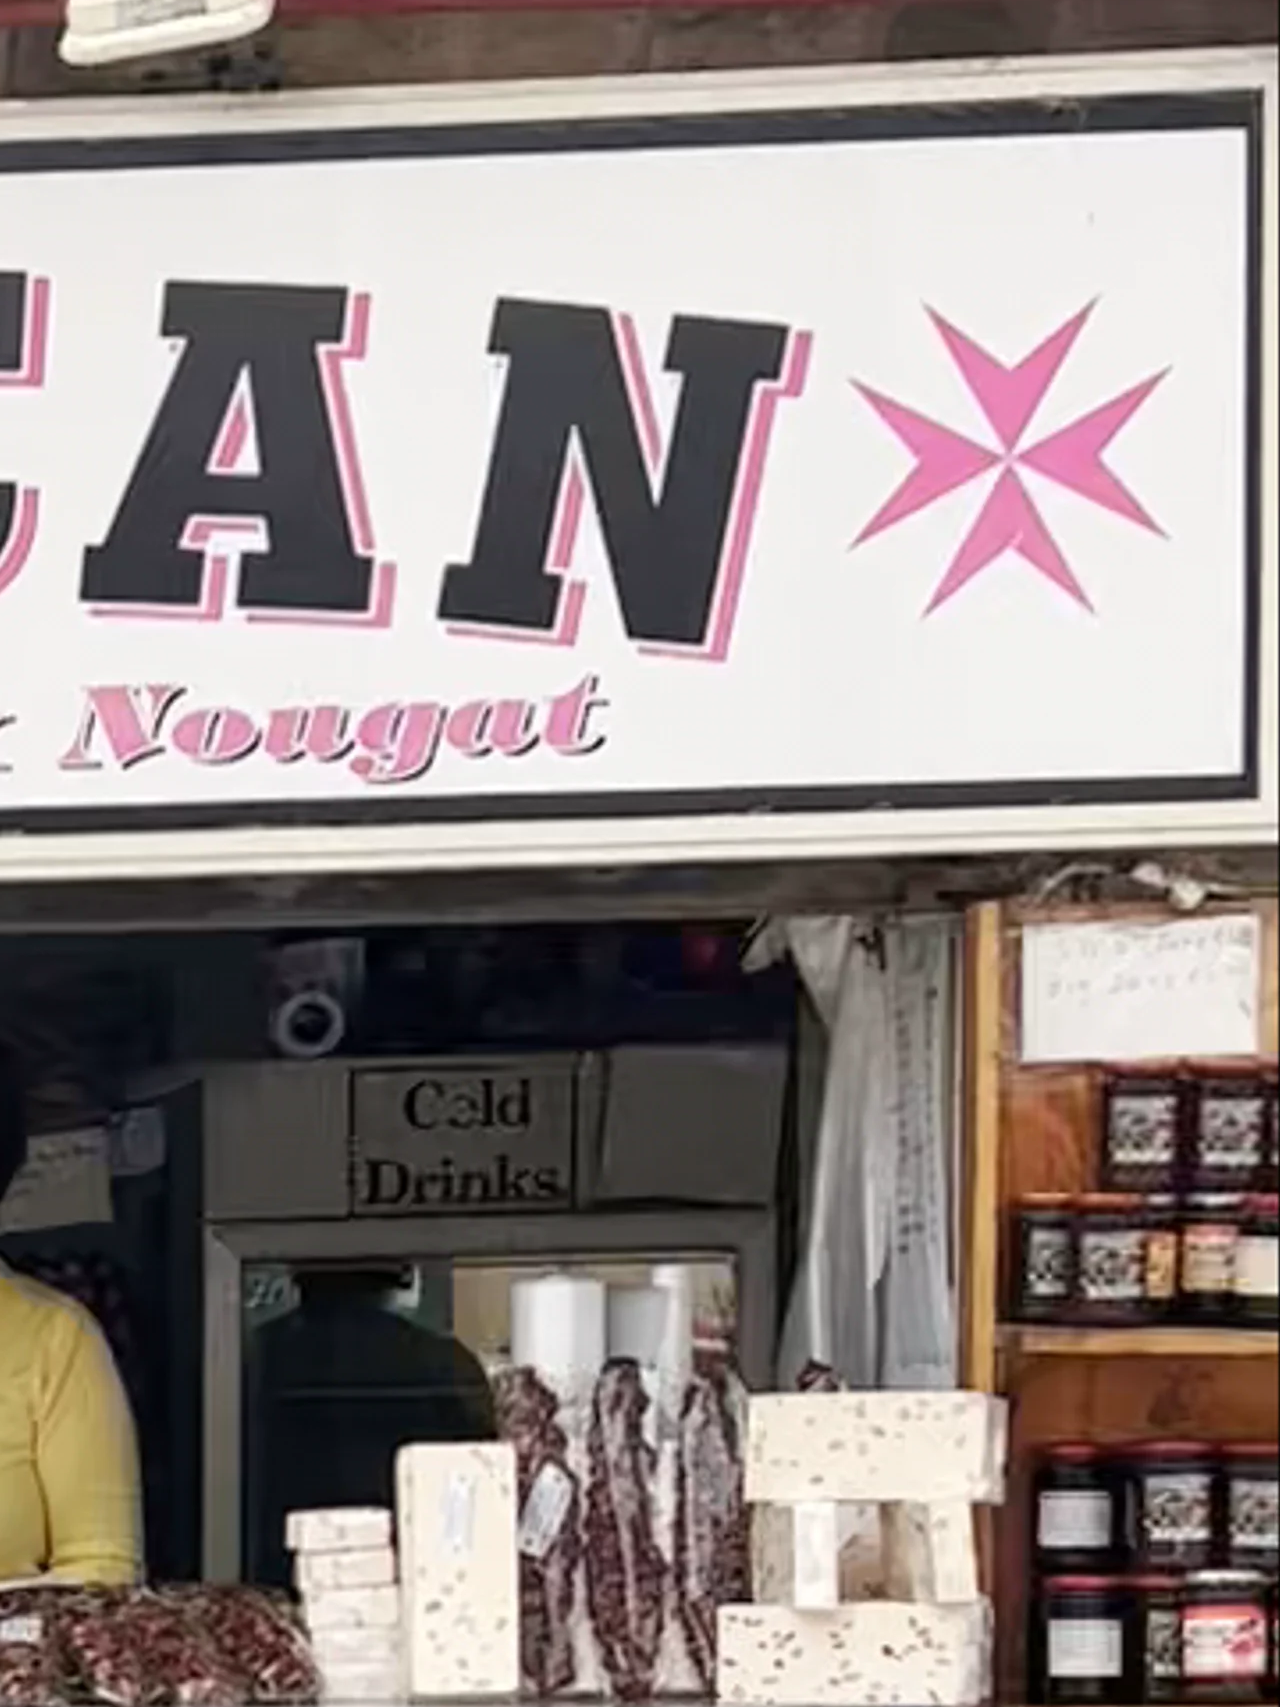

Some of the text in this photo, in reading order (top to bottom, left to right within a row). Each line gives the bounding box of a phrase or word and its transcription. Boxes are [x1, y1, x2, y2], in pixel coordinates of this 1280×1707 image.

[57, 673, 612, 785] Nougat
[402, 1078, 532, 1131] Cold
[362, 1153, 562, 1207] Drinks
